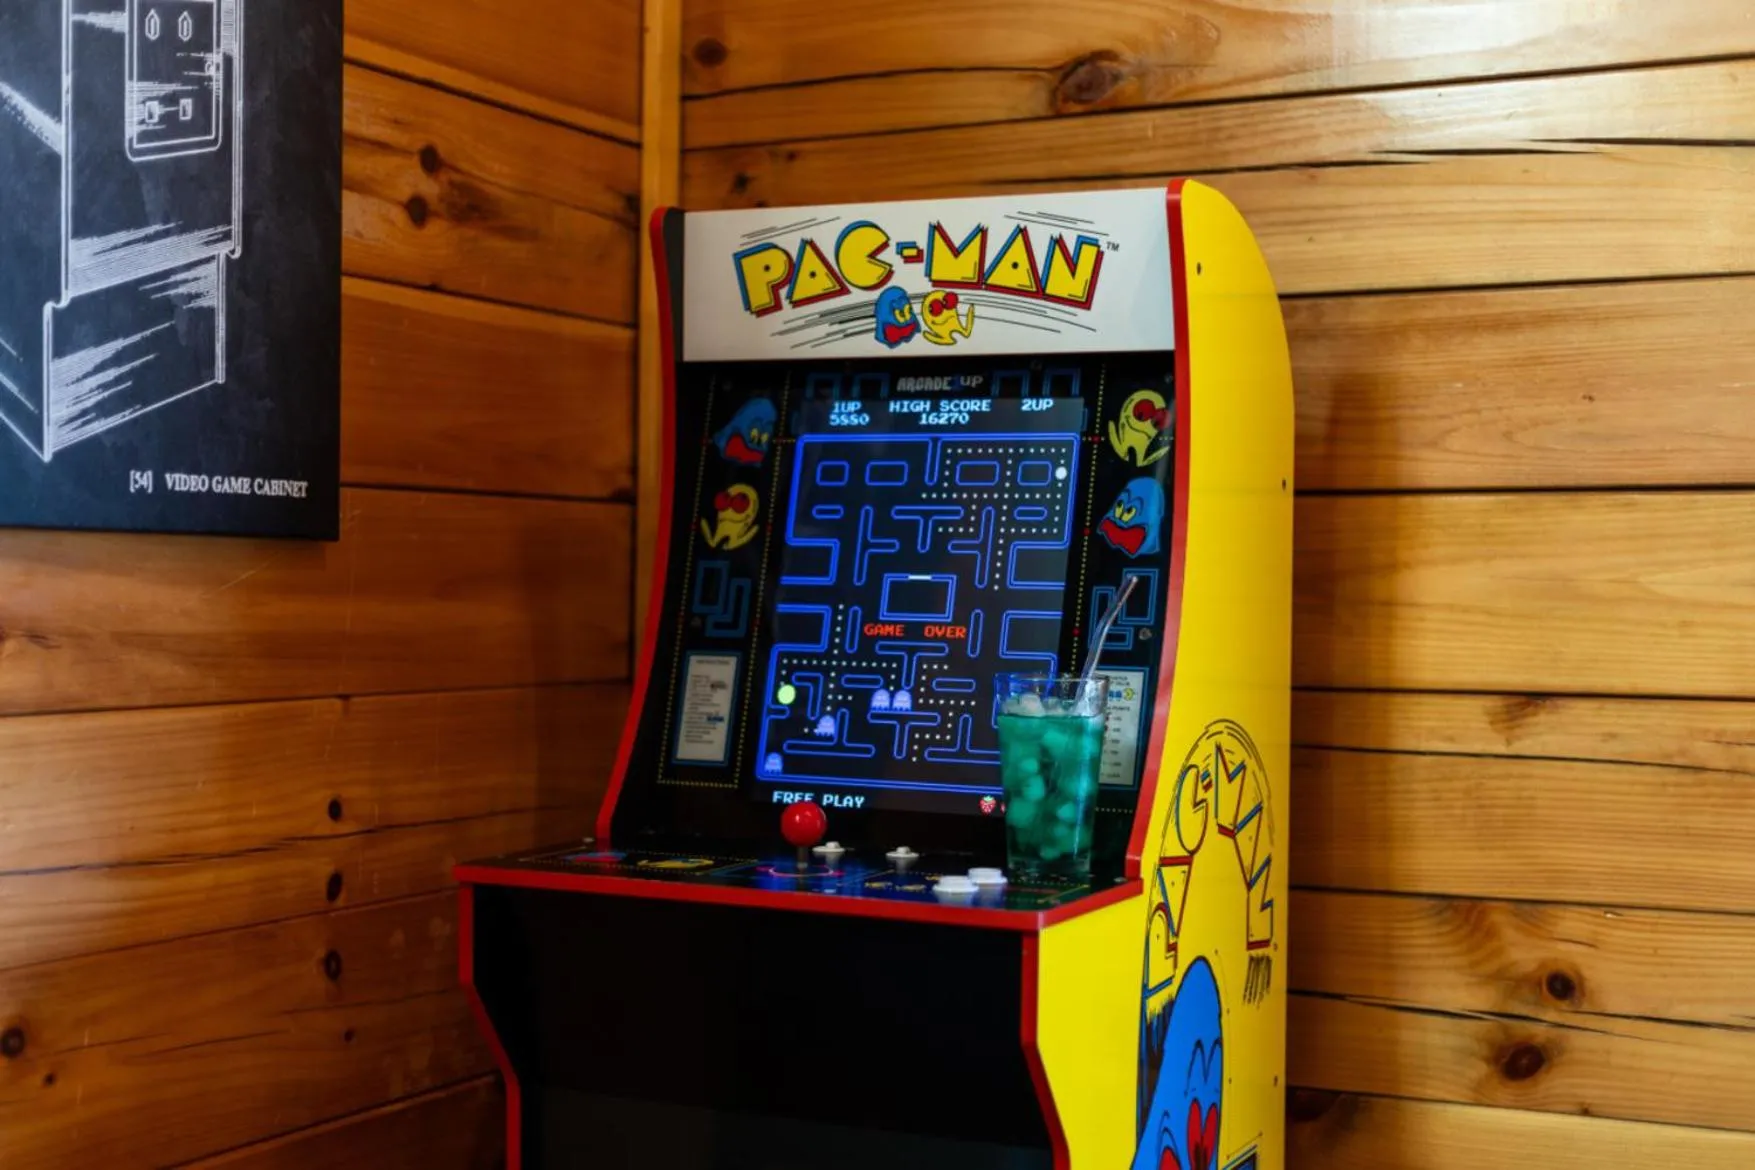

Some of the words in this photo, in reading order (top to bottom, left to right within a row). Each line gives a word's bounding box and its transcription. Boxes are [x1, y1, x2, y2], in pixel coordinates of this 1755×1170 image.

[732, 220, 1104, 318] PAC-MAN
[832, 401, 862, 413] 1UP
[889, 400, 930, 413] HIGH
[939, 399, 992, 412] SCORE
[1021, 398, 1054, 411] 2UP
[919, 412, 969, 425] 16270
[164, 473, 209, 493] VIDEO
[212, 476, 251, 494] GAME
[254, 479, 308, 498] CABINET
[864, 623, 904, 636] GAME
[924, 625, 967, 638] OVER
[822, 793, 865, 808] PLAY
